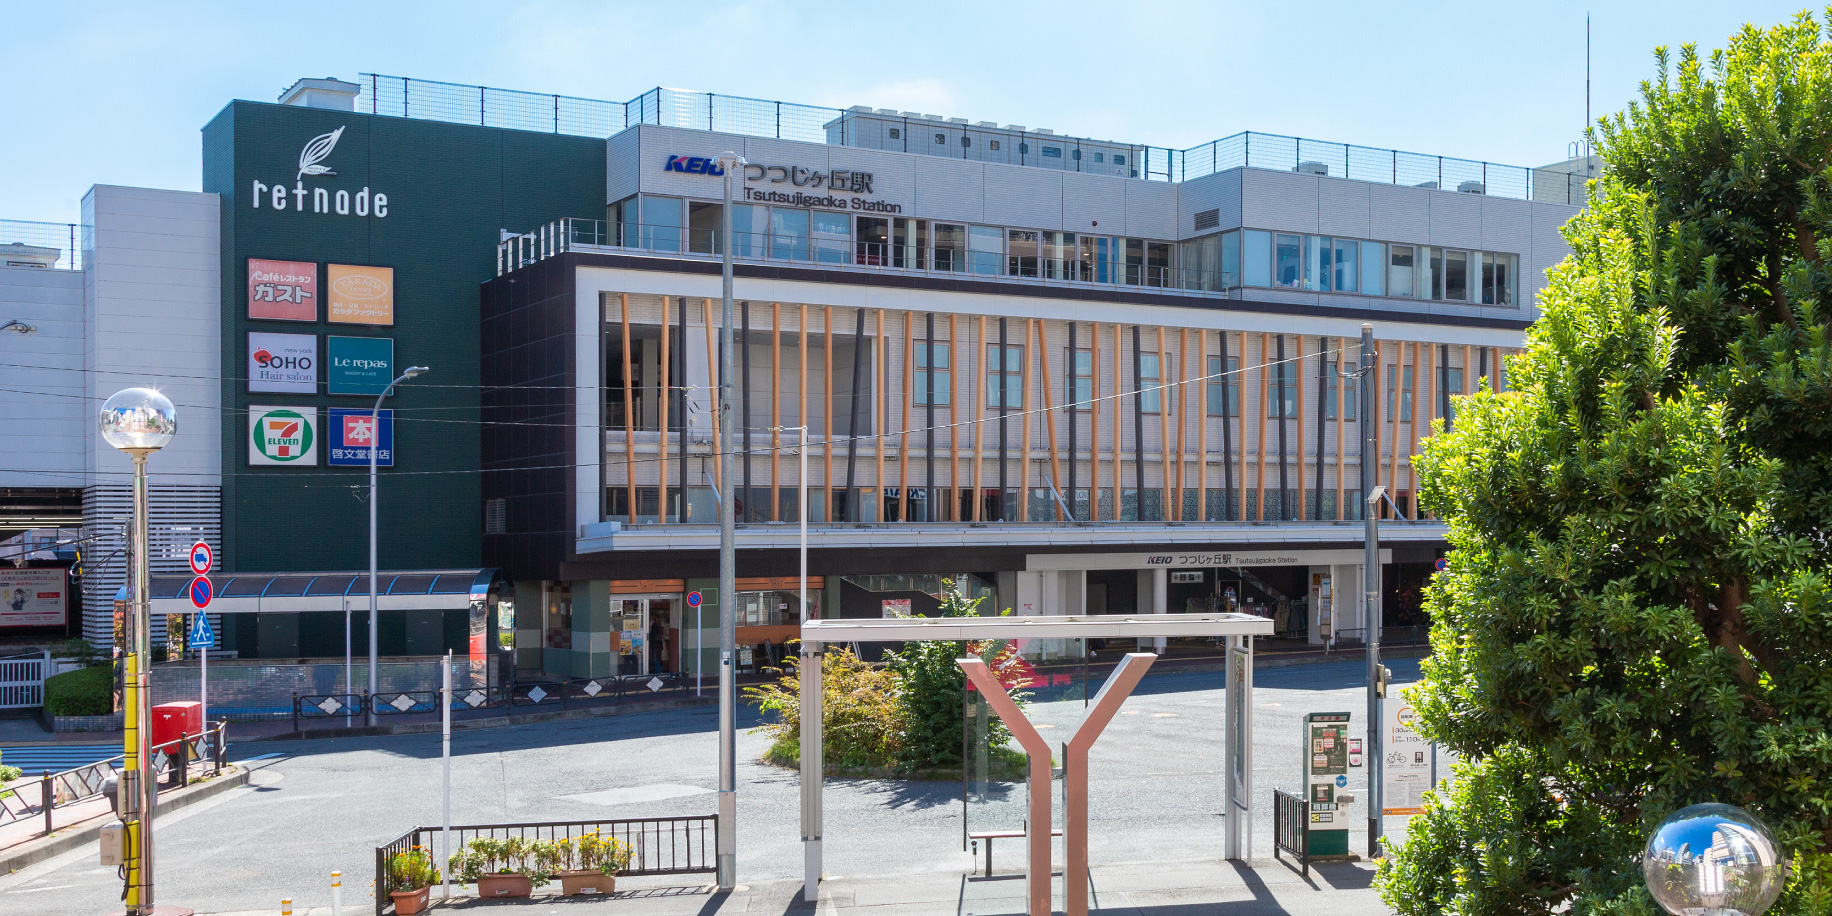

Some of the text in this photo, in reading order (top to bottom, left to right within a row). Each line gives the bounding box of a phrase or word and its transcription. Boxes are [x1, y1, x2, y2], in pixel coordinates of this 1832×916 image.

[745, 187, 902, 214] Tsutsujigaoka Station
[254, 283, 312, 304] ガスト
[259, 356, 312, 370] SOHO
[334, 357, 387, 369] Le repas
[260, 371, 312, 381] Hair salon
[1147, 556, 1173, 564] KEIO
